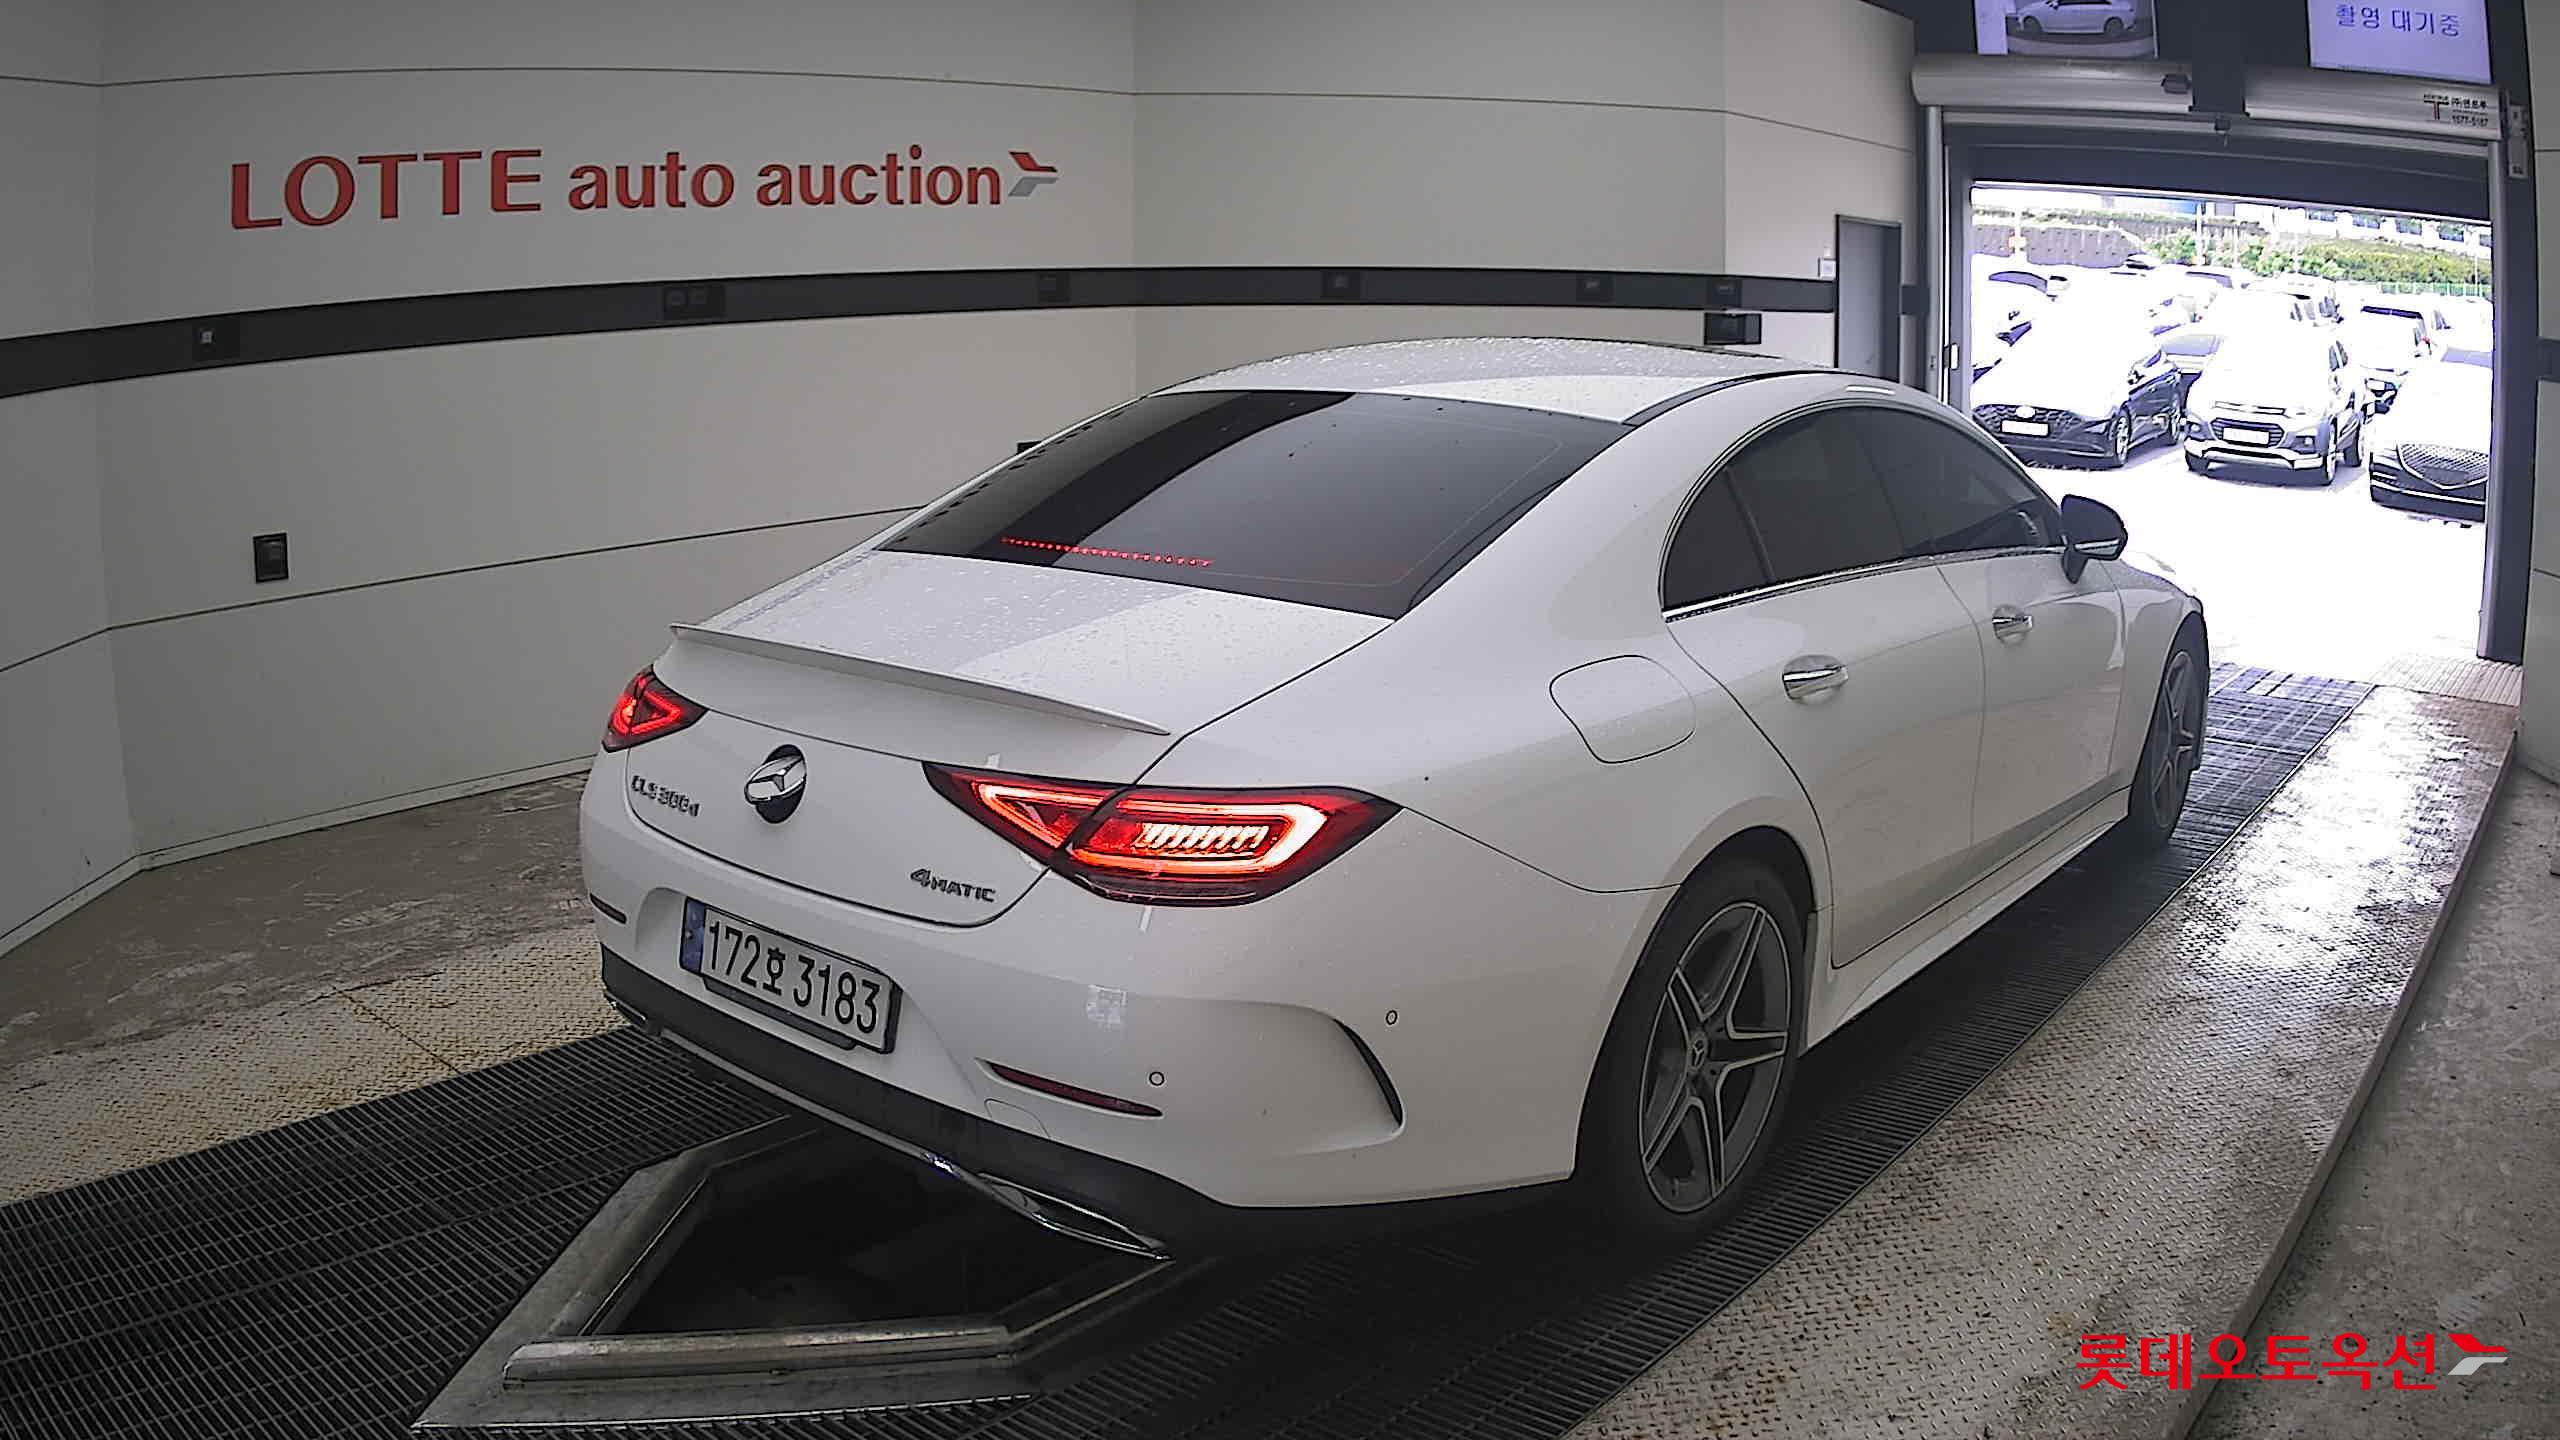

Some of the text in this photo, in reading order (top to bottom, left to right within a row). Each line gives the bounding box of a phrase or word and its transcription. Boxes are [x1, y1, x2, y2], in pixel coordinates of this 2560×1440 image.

[2336, 4, 2380, 29] 촬영
[230, 145, 1003, 229] LOTTE auto auction
[910, 868, 996, 903] 4MATIC
[793, 954, 881, 1034] 3183
